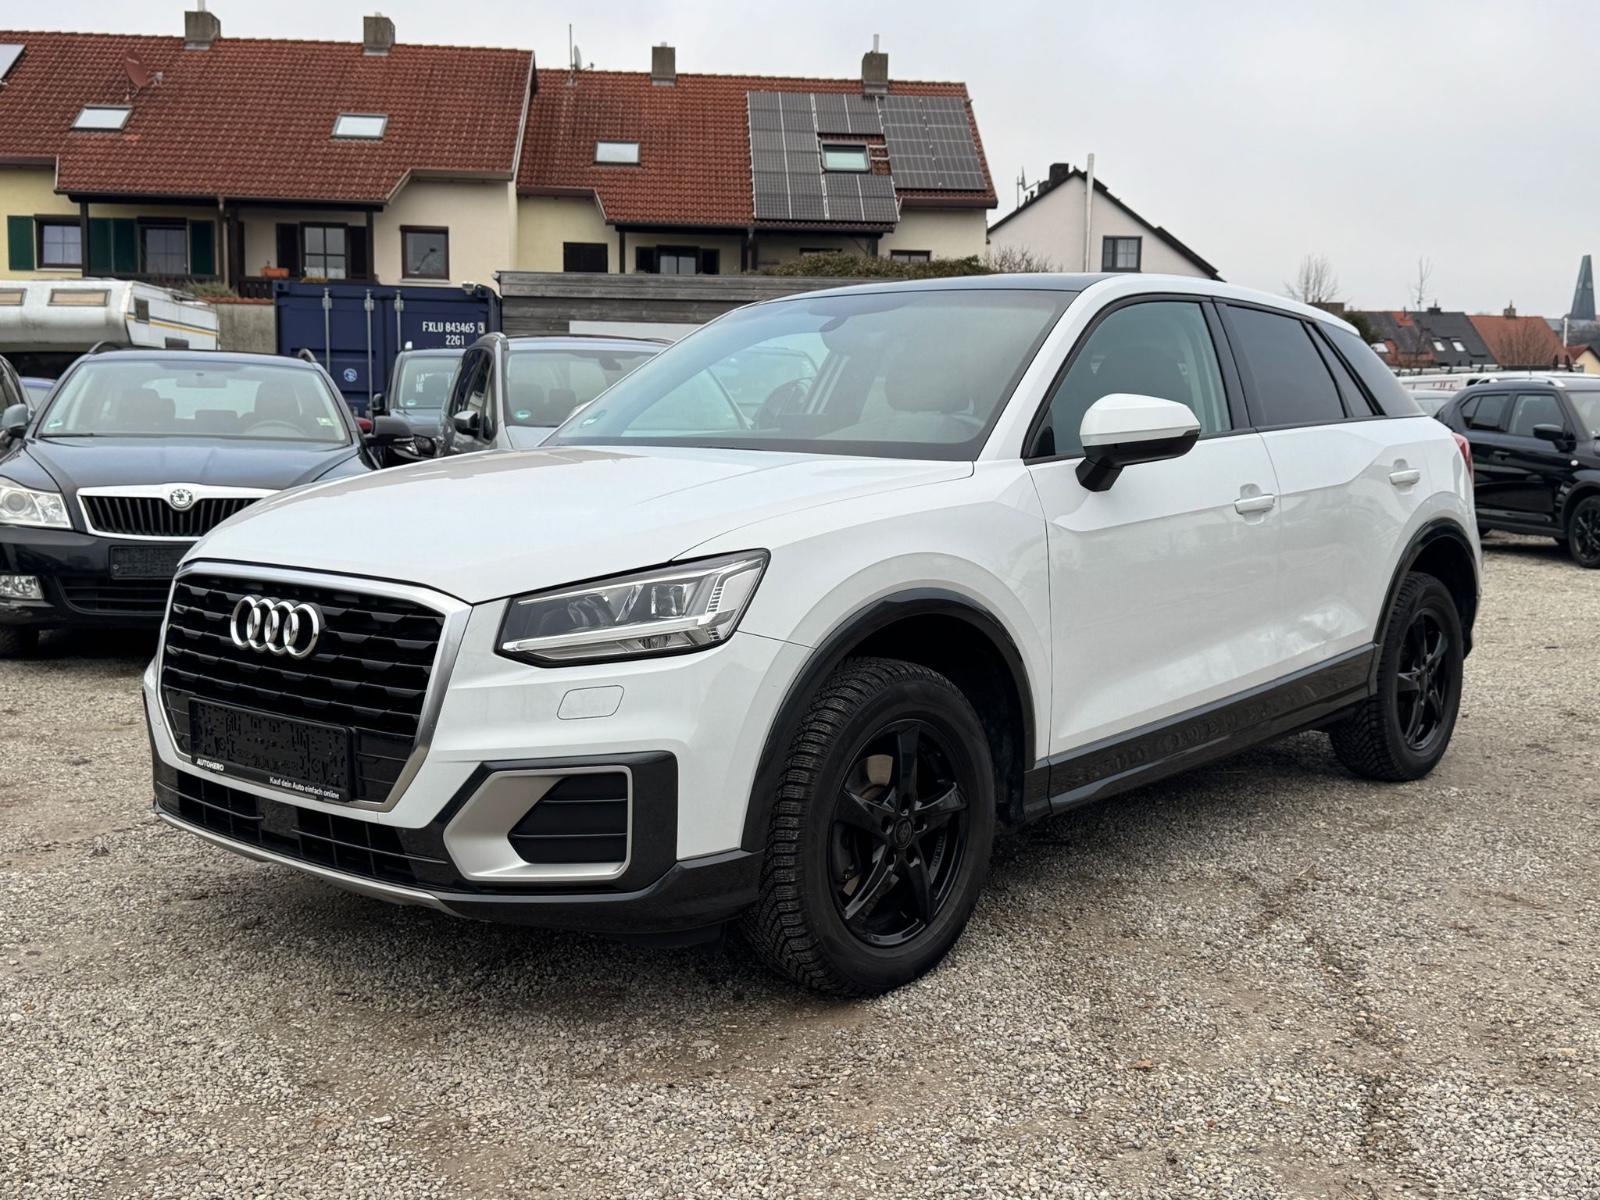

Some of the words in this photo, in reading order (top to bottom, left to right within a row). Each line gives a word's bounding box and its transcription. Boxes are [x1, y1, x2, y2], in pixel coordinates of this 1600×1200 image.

[422, 321, 444, 332] FXLU
[445, 322, 475, 333] 843465
[445, 335, 465, 346] 22G1
[196, 758, 225, 771] AUTOHERO
[269, 776, 281, 786] Kauf
[281, 779, 292, 788] dein
[292, 782, 305, 792] Auto
[304, 785, 323, 796] einfach
[323, 790, 340, 800] online
